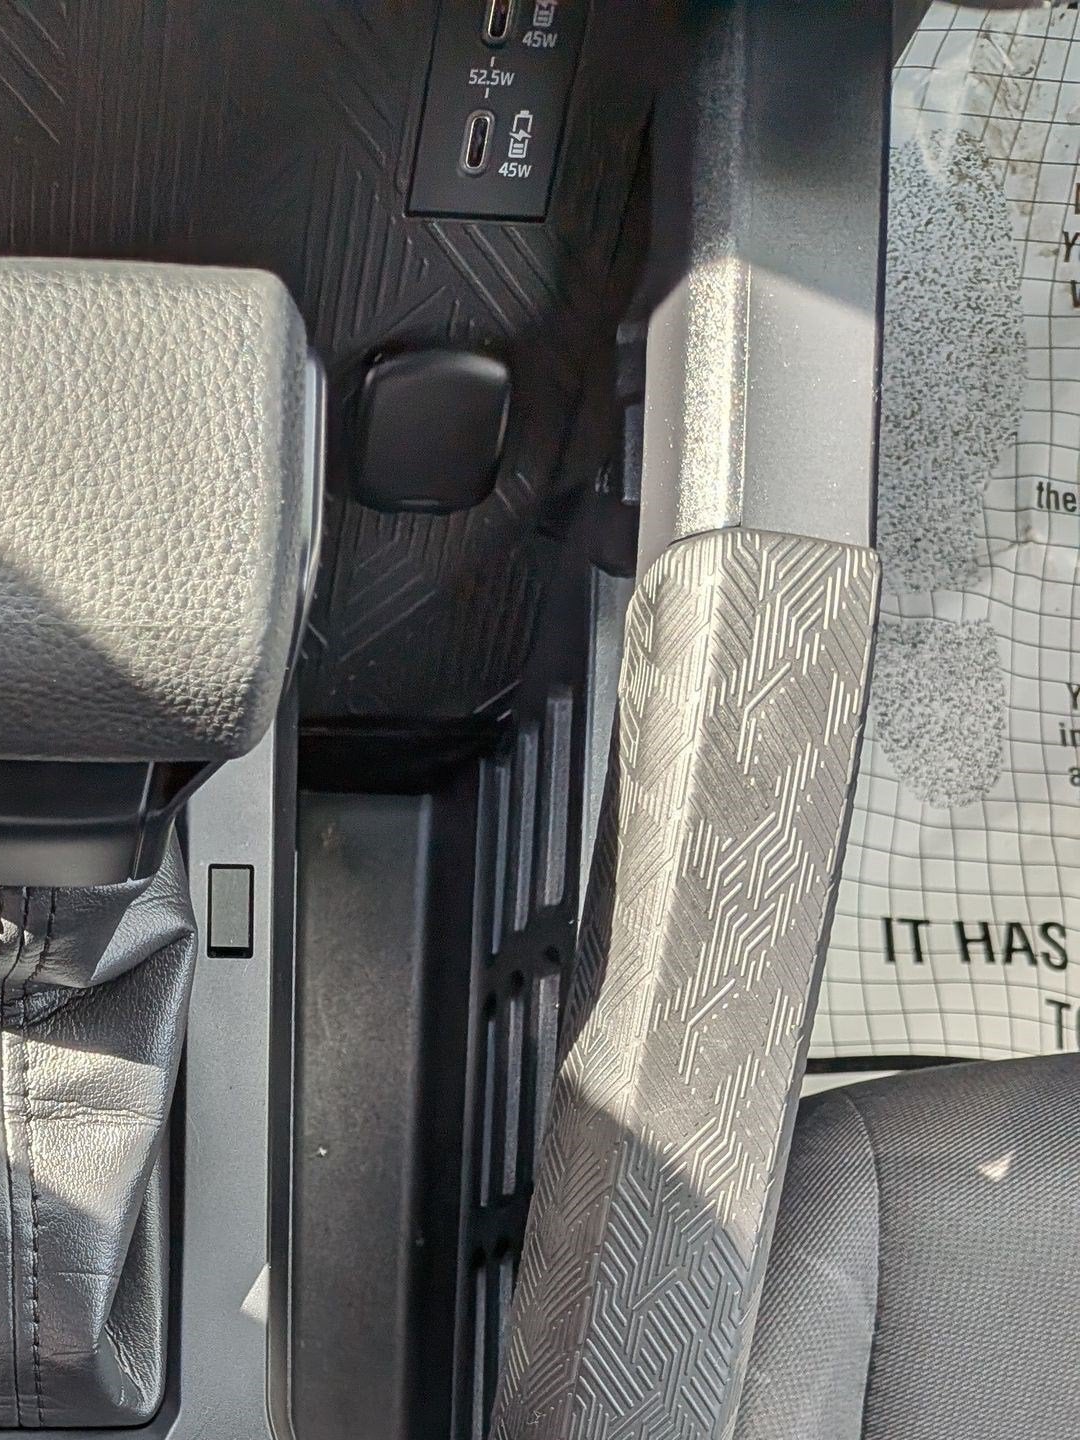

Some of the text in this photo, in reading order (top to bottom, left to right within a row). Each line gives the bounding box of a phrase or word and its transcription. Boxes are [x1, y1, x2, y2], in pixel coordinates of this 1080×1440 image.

[522, 30, 558, 48] 45W
[468, 69, 515, 86] 52.5W
[498, 162, 532, 178] 45W
[1036, 481, 1078, 513] the
[883, 916, 1069, 971] IT HAS
